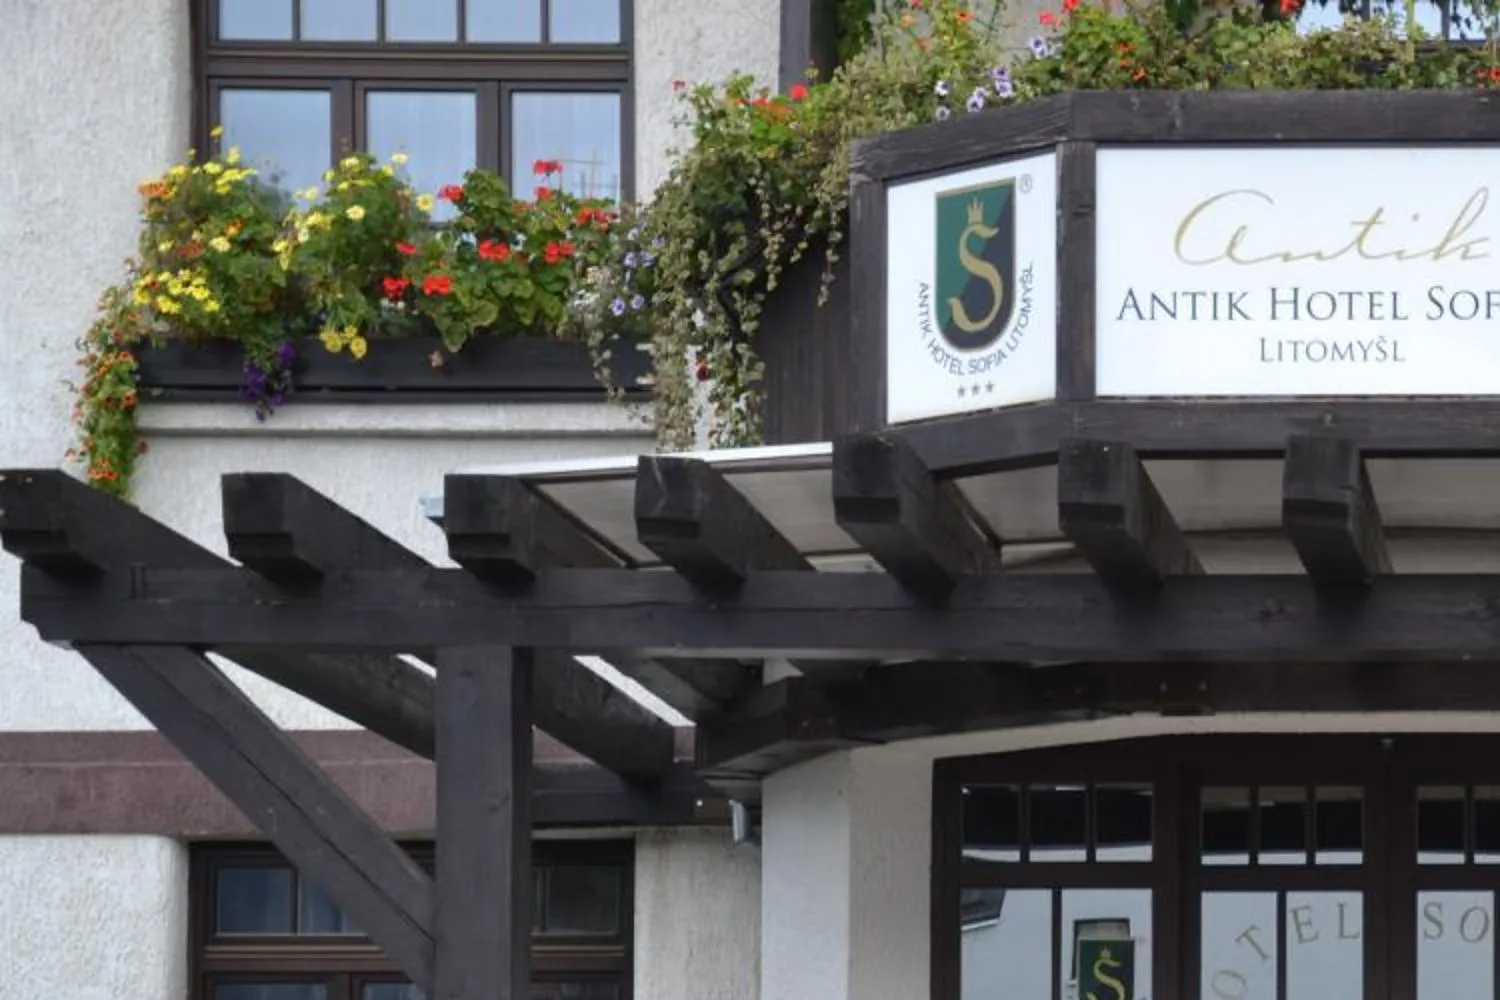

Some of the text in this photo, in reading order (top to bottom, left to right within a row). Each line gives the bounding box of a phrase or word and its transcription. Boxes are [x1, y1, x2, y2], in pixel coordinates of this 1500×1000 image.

[1173, 186, 1490, 265] Antik
[917, 282, 934, 339] ANTIK
[928, 336, 966, 377] HOTEL
[967, 347, 1008, 376] SOFIA
[1115, 287, 1252, 321] ANTIK
[1269, 286, 1408, 321] HOTEL
[1259, 335, 1405, 363] LITOMYŠL
